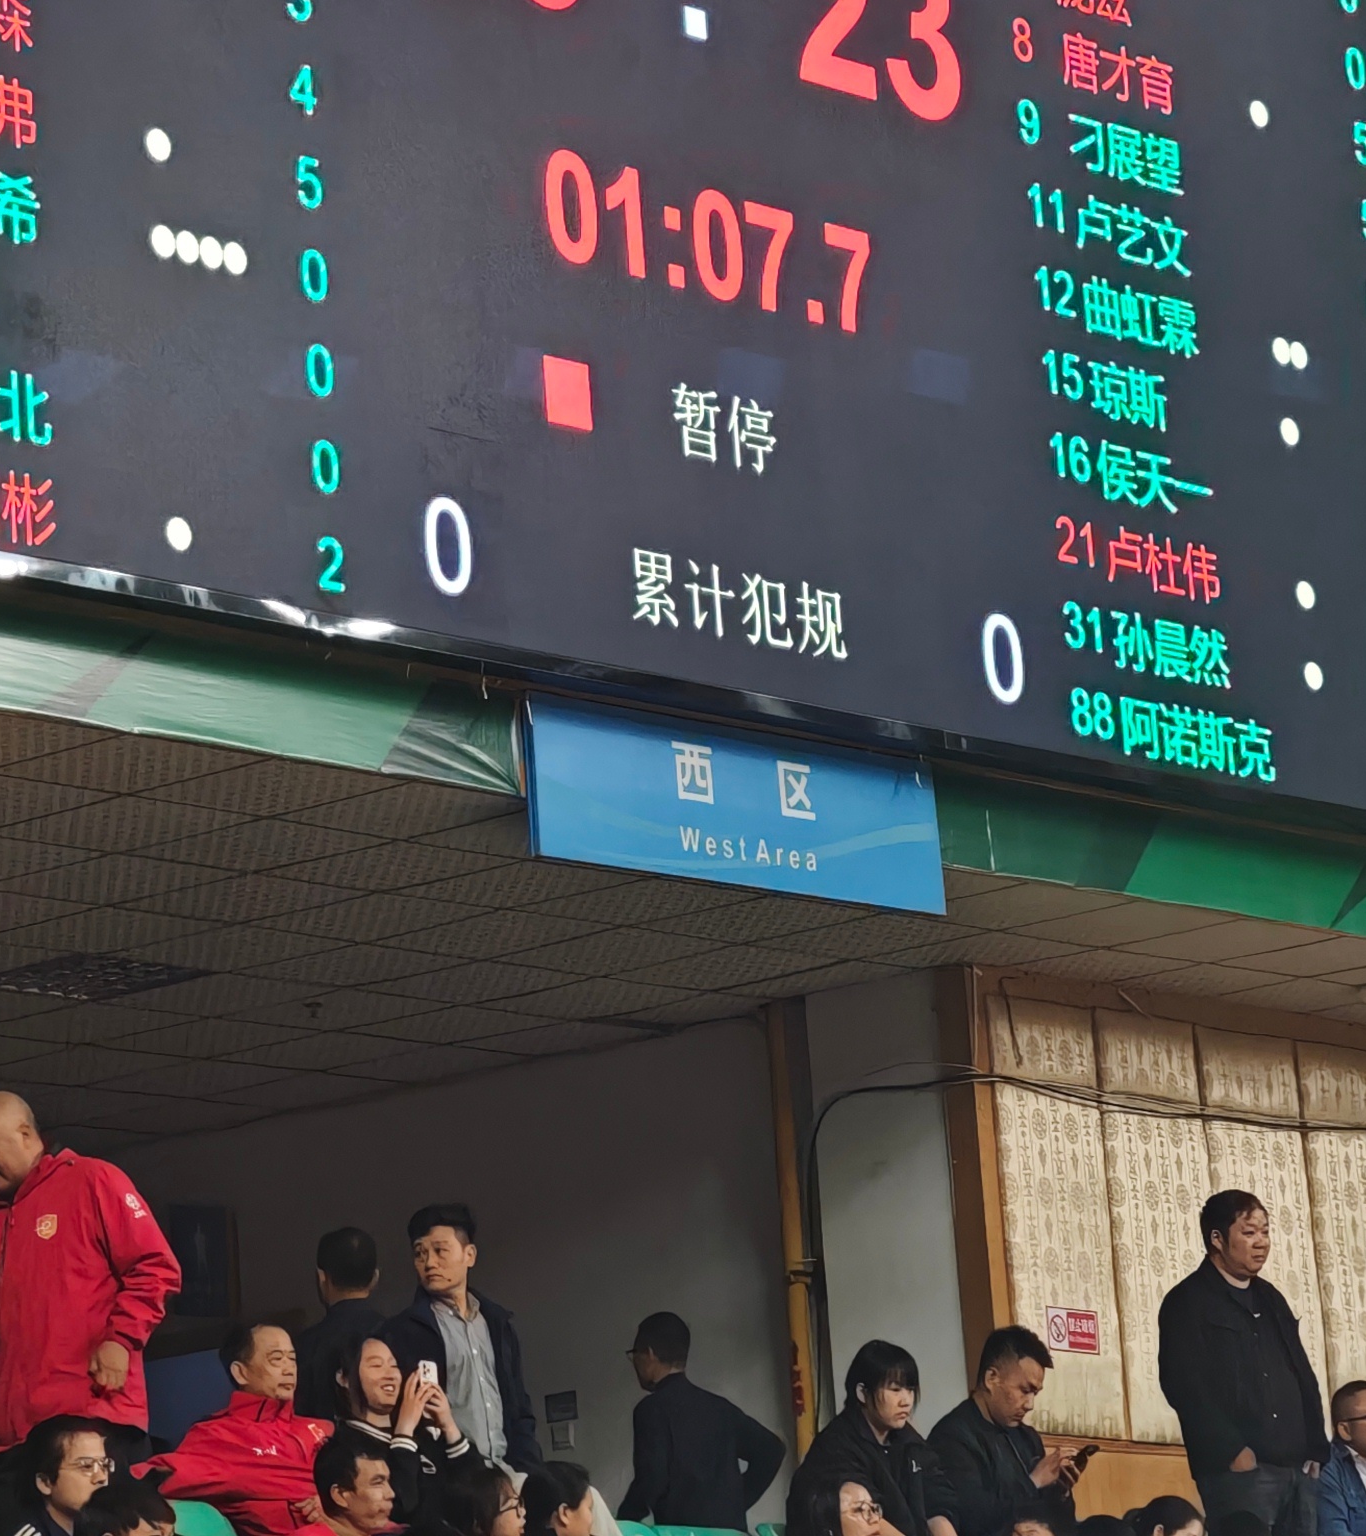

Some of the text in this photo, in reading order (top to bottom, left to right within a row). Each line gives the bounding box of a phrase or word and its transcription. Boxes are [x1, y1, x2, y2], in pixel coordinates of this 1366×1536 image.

[287, 64, 318, 118] 4
[1013, 17, 1034, 64] 8
[1063, 32, 1175, 116] 唐才育
[1344, 46, 1366, 90] 0
[297, 156, 323, 212] 5
[1016, 98, 1040, 144] 9
[1068, 112, 1185, 196] 刁展望
[544, 148, 873, 334] 01:07.7
[1027, 182, 1065, 233] 11
[1076, 193, 1192, 278] 卢艺文
[299, 249, 331, 304] 0
[1033, 265, 1078, 319] 12
[1082, 275, 1201, 359] 曲虹霖
[305, 343, 336, 397] 0
[1042, 349, 1084, 401] 15
[1088, 360, 1168, 432] 琼斯
[311, 439, 342, 495] 0
[672, 382, 778, 476] 暂停
[1049, 431, 1093, 484] 16
[1096, 439, 1215, 514] 侯天一
[318, 536, 348, 595] 2
[424, 494, 474, 599] 0
[1054, 515, 1097, 568] 21
[1107, 525, 1222, 605] 卢杜伟
[630, 547, 849, 660] 累计犯规
[1062, 600, 1103, 654] 31
[1111, 610, 1232, 691] 孙晨然
[980, 611, 1026, 705] 0
[1069, 687, 1116, 741] 88
[1120, 696, 1276, 784] 阿诺斯克
[679, 825, 819, 873] West Area
